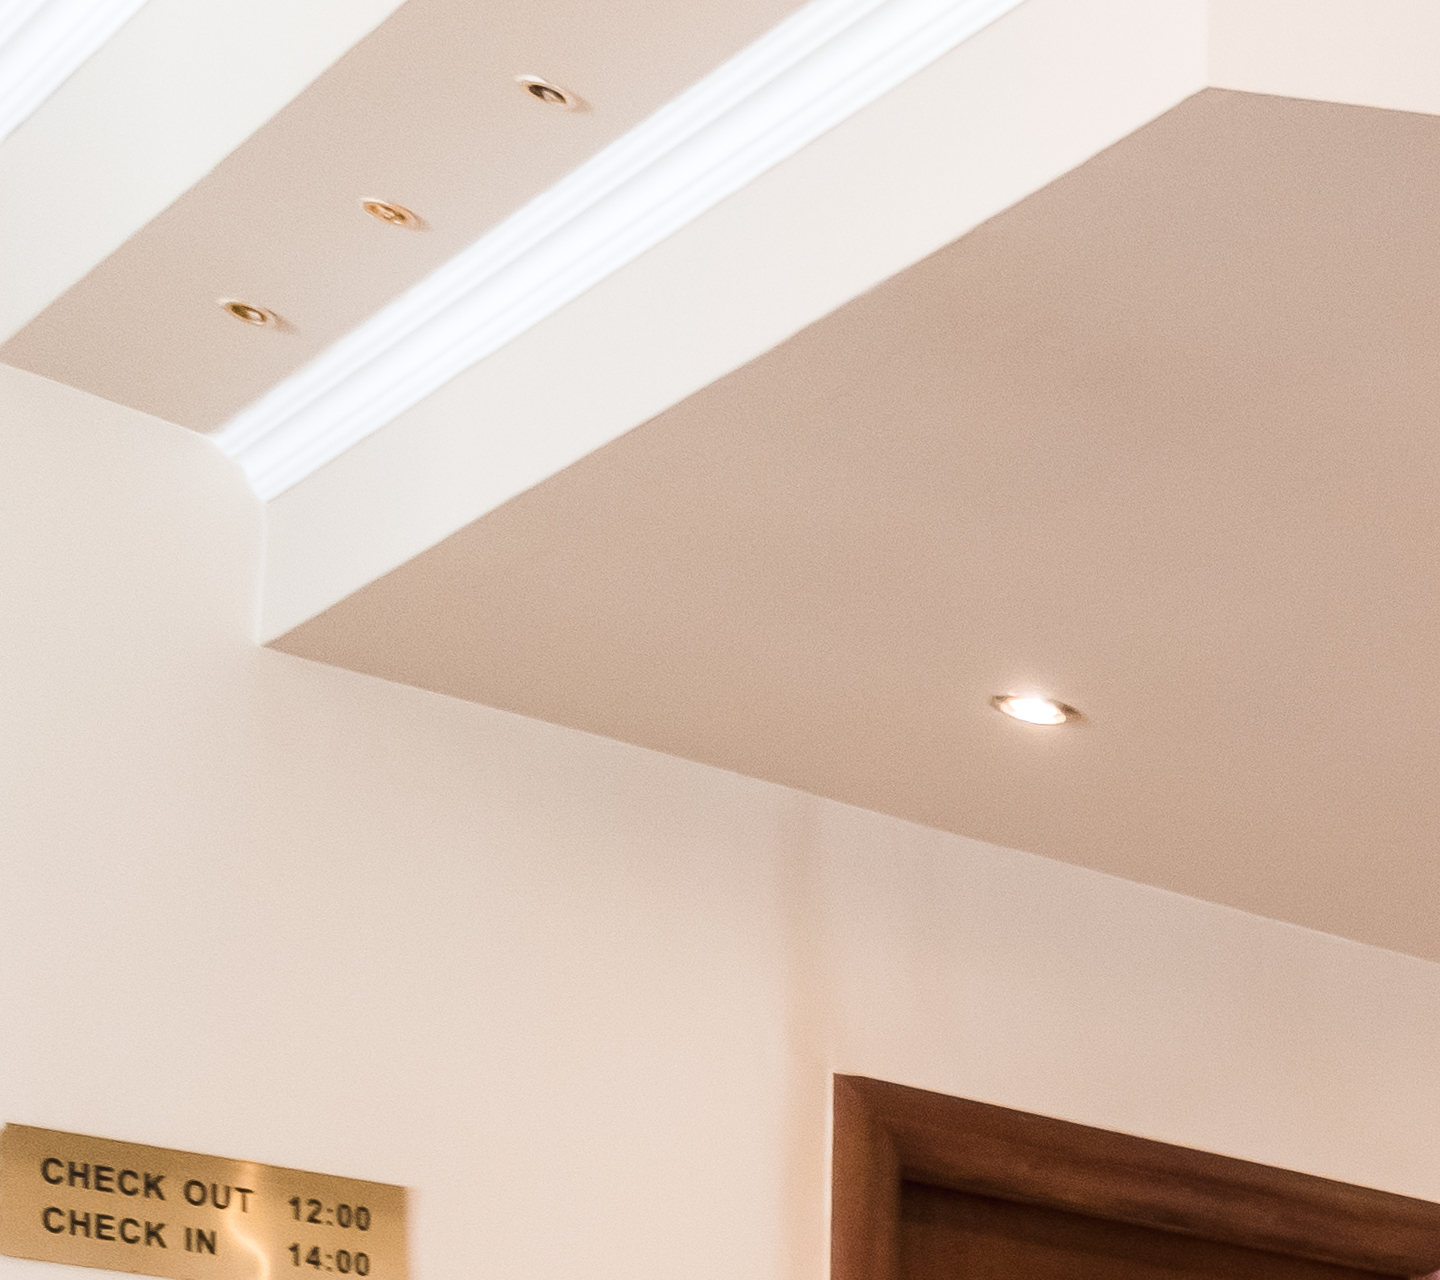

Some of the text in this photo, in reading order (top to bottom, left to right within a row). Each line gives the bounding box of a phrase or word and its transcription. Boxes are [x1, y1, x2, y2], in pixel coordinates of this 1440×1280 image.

[40, 1158, 371, 1231] CHECK OUT 12:00
[41, 1207, 371, 1276] CHECK IN 14:00
